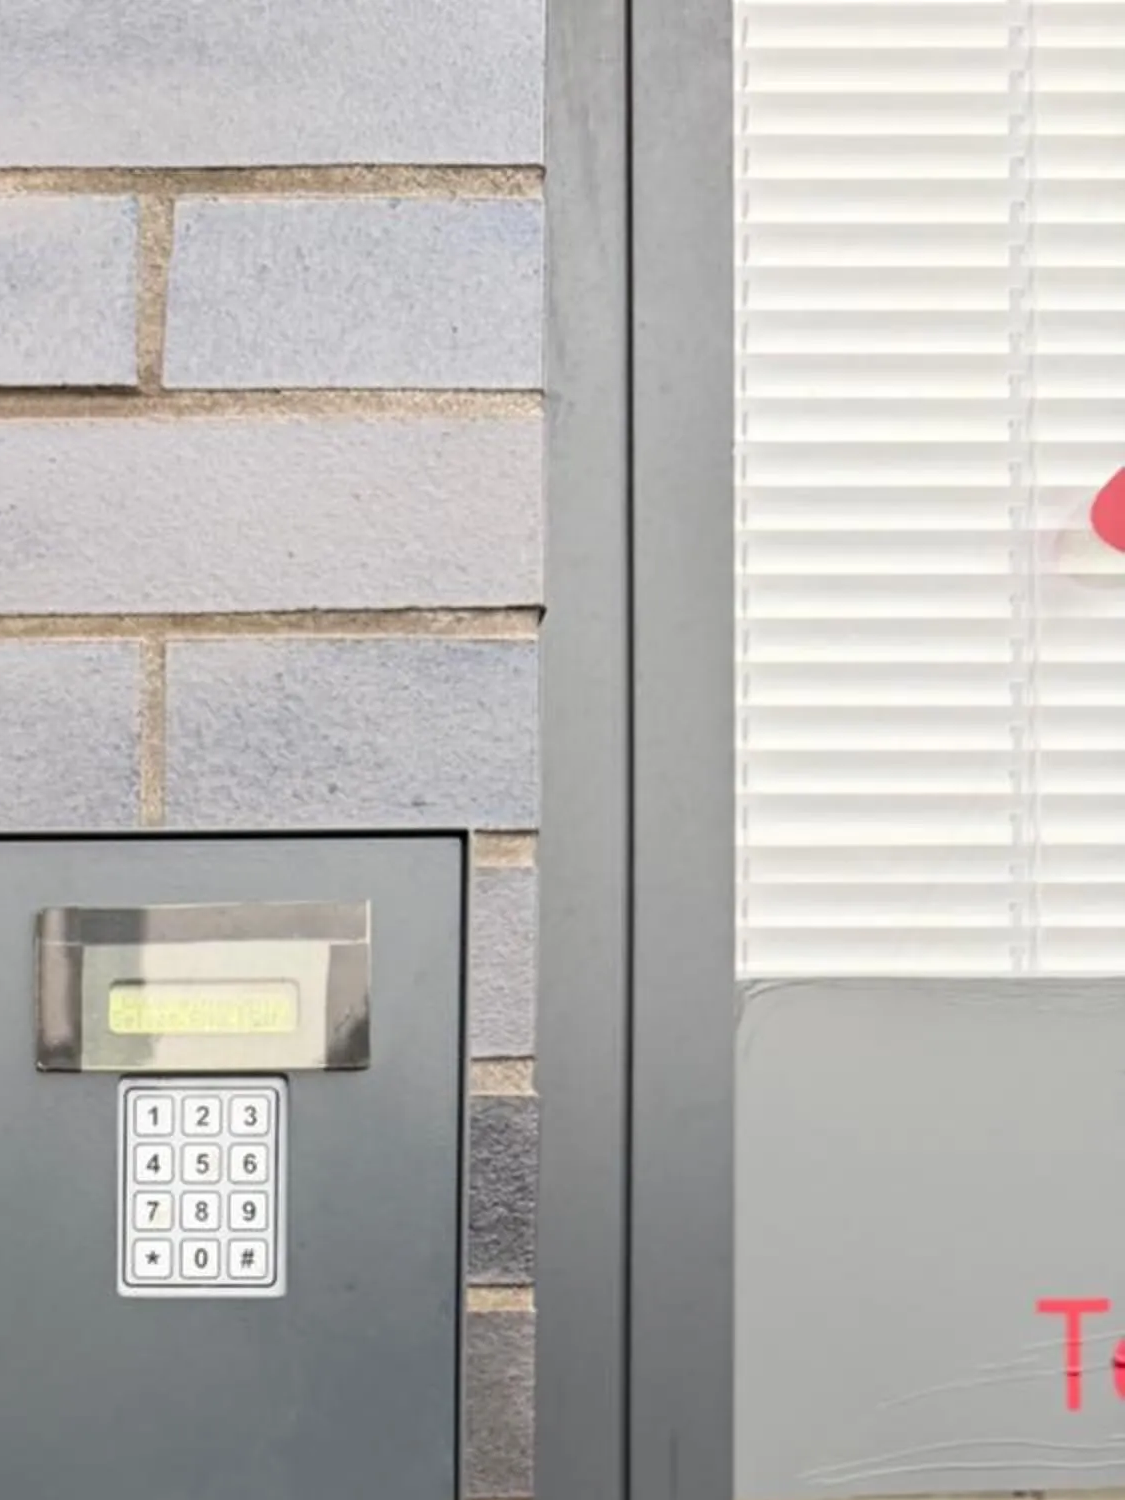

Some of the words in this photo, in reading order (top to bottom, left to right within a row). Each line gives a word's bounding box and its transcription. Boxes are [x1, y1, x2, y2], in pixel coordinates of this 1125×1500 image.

[148, 1106, 158, 1126] 1
[196, 1106, 210, 1126] 2
[244, 1106, 258, 1126] 3
[146, 1154, 161, 1174] 4
[196, 1154, 209, 1174] 5
[243, 1154, 257, 1174] 6
[146, 1201, 160, 1222] 7
[195, 1201, 209, 1222] 8
[242, 1201, 256, 1222] 9
[194, 1249, 208, 1268] 0
[1035, 1297, 1125, 1412] T
